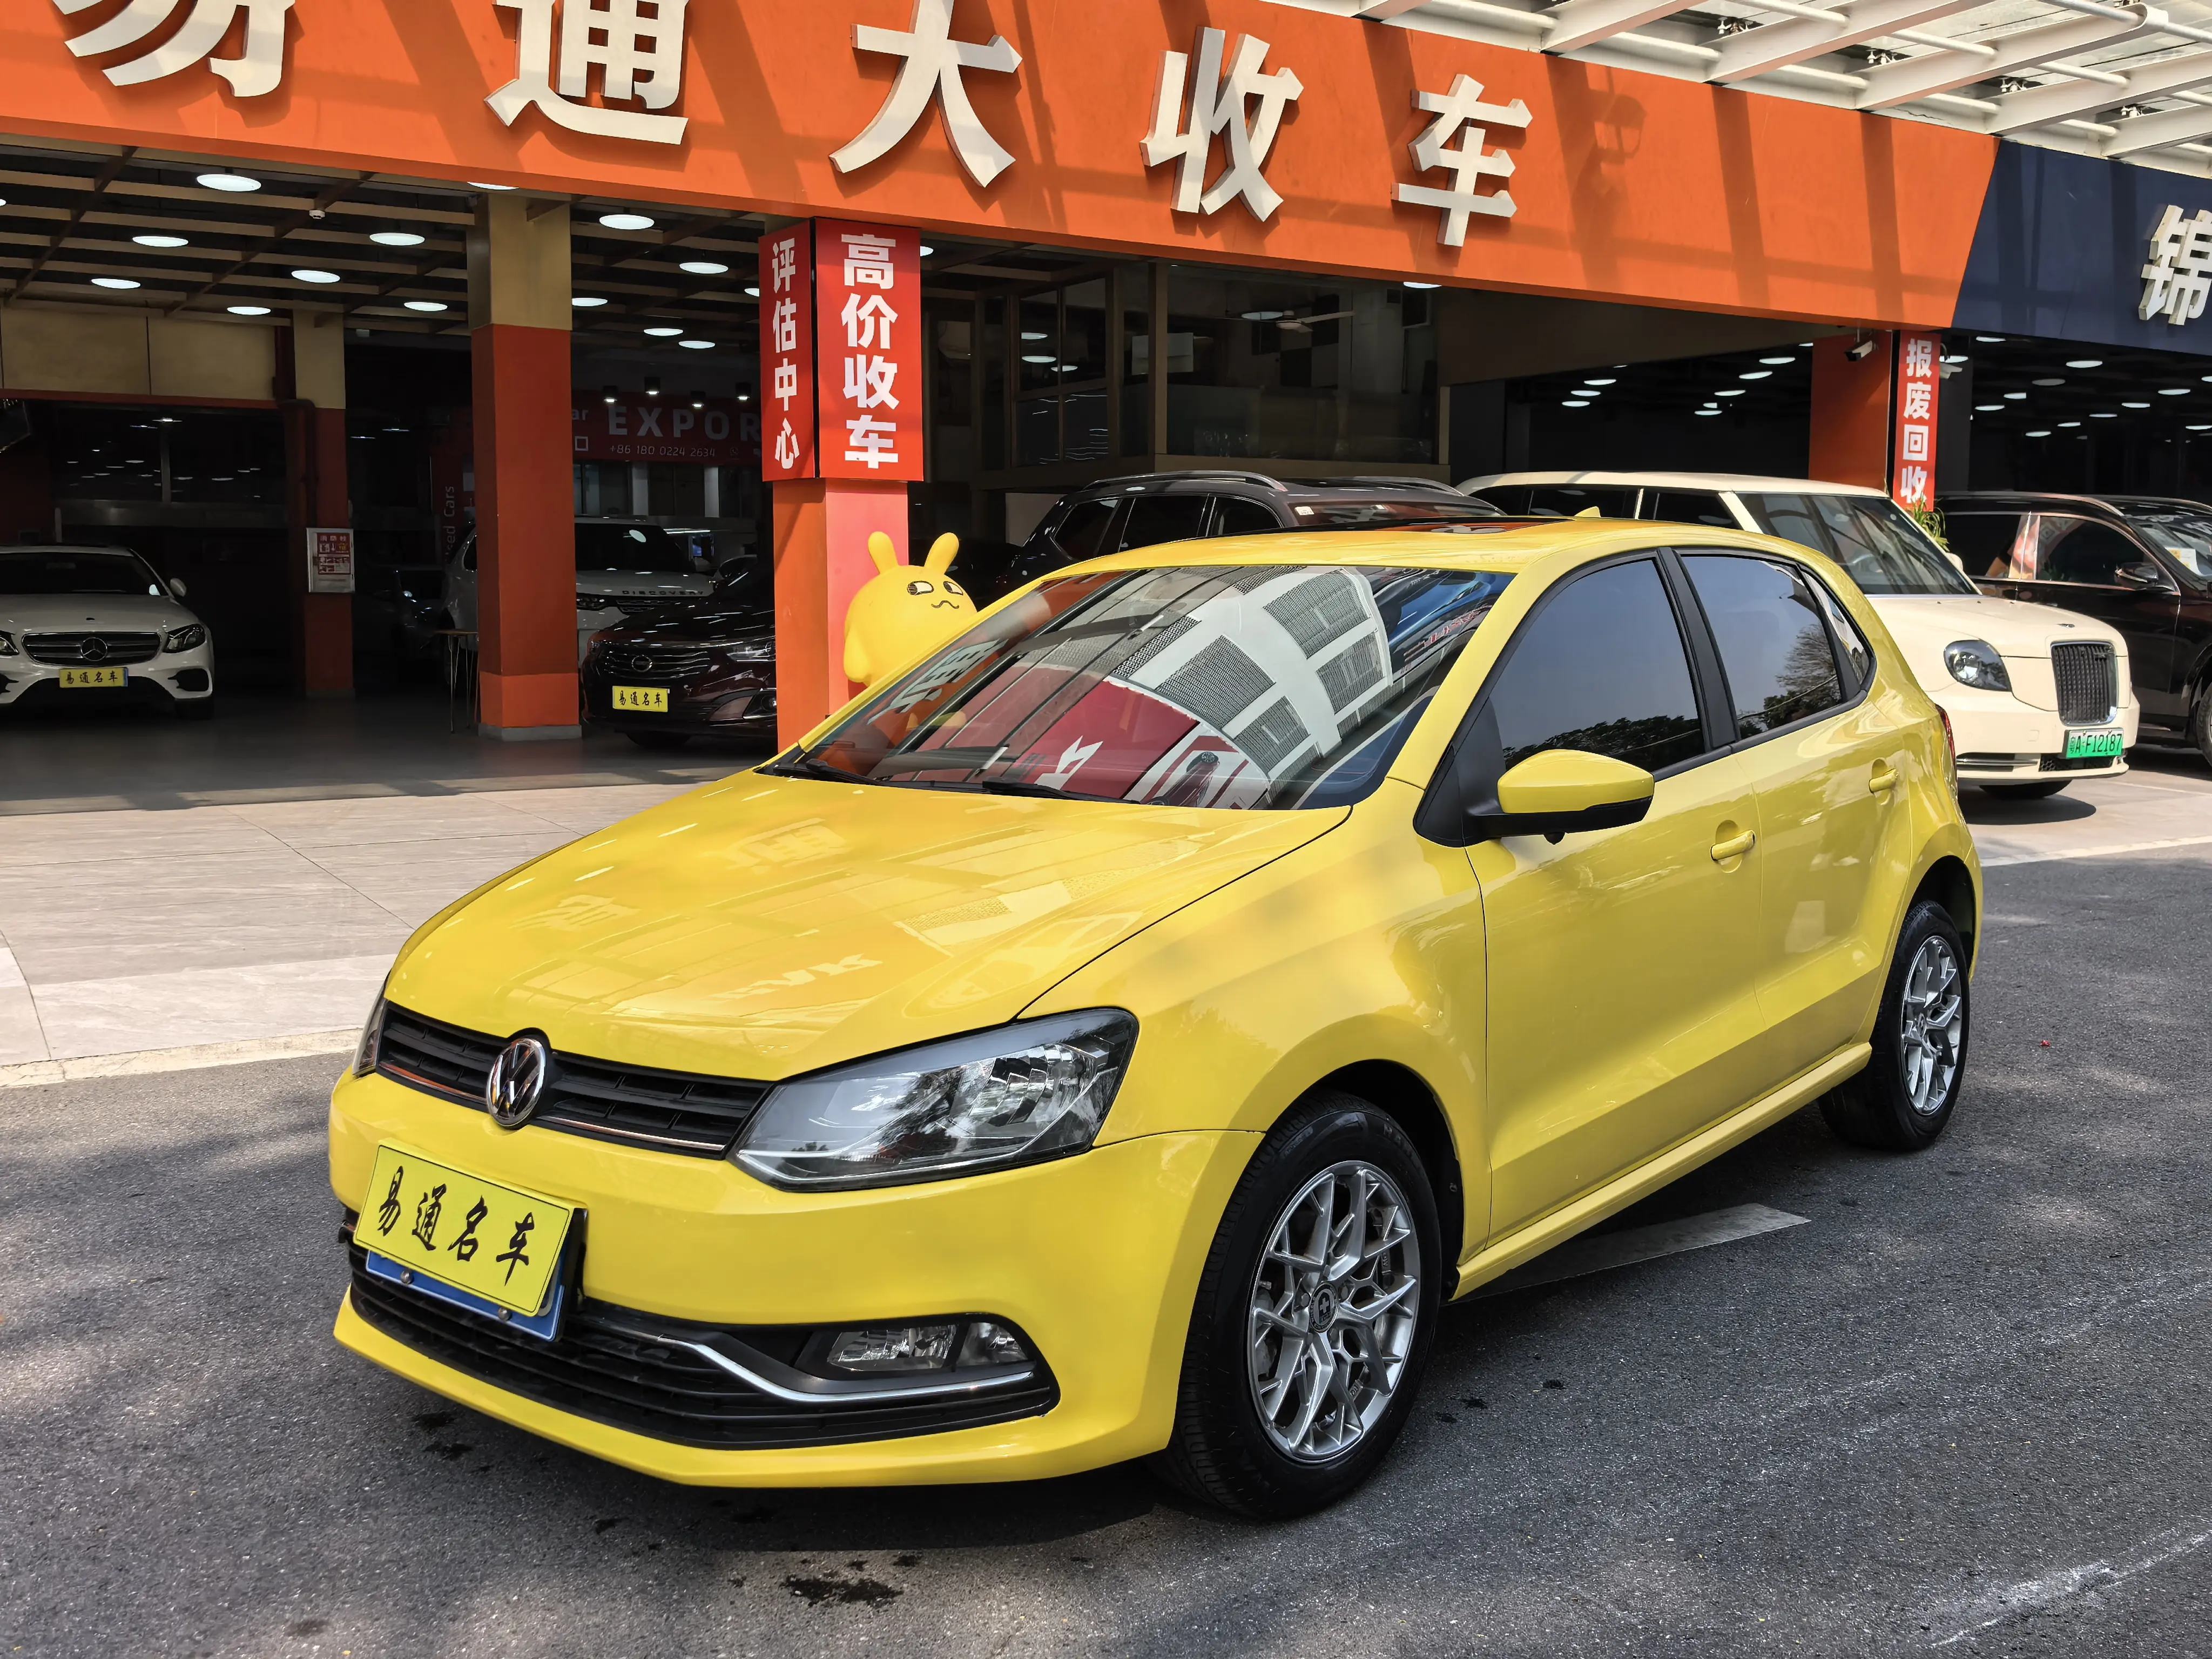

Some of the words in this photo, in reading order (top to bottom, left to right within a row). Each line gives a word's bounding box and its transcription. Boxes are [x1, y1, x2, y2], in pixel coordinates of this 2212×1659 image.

[772, 238, 800, 469] 评估中心
[841, 234, 900, 469] 高价收车
[610, 444, 631, 454] +86
[637, 445, 655, 455] 180
[660, 447, 685, 456] 0224
[691, 448, 716, 457] 2634
[1900, 338, 1932, 503] 报废回收
[443, 486, 455, 517] Cars
[66, 671, 118, 684] 易通名车
[619, 690, 662, 707] 易通名车
[377, 1165, 535, 1286] 易通名车
